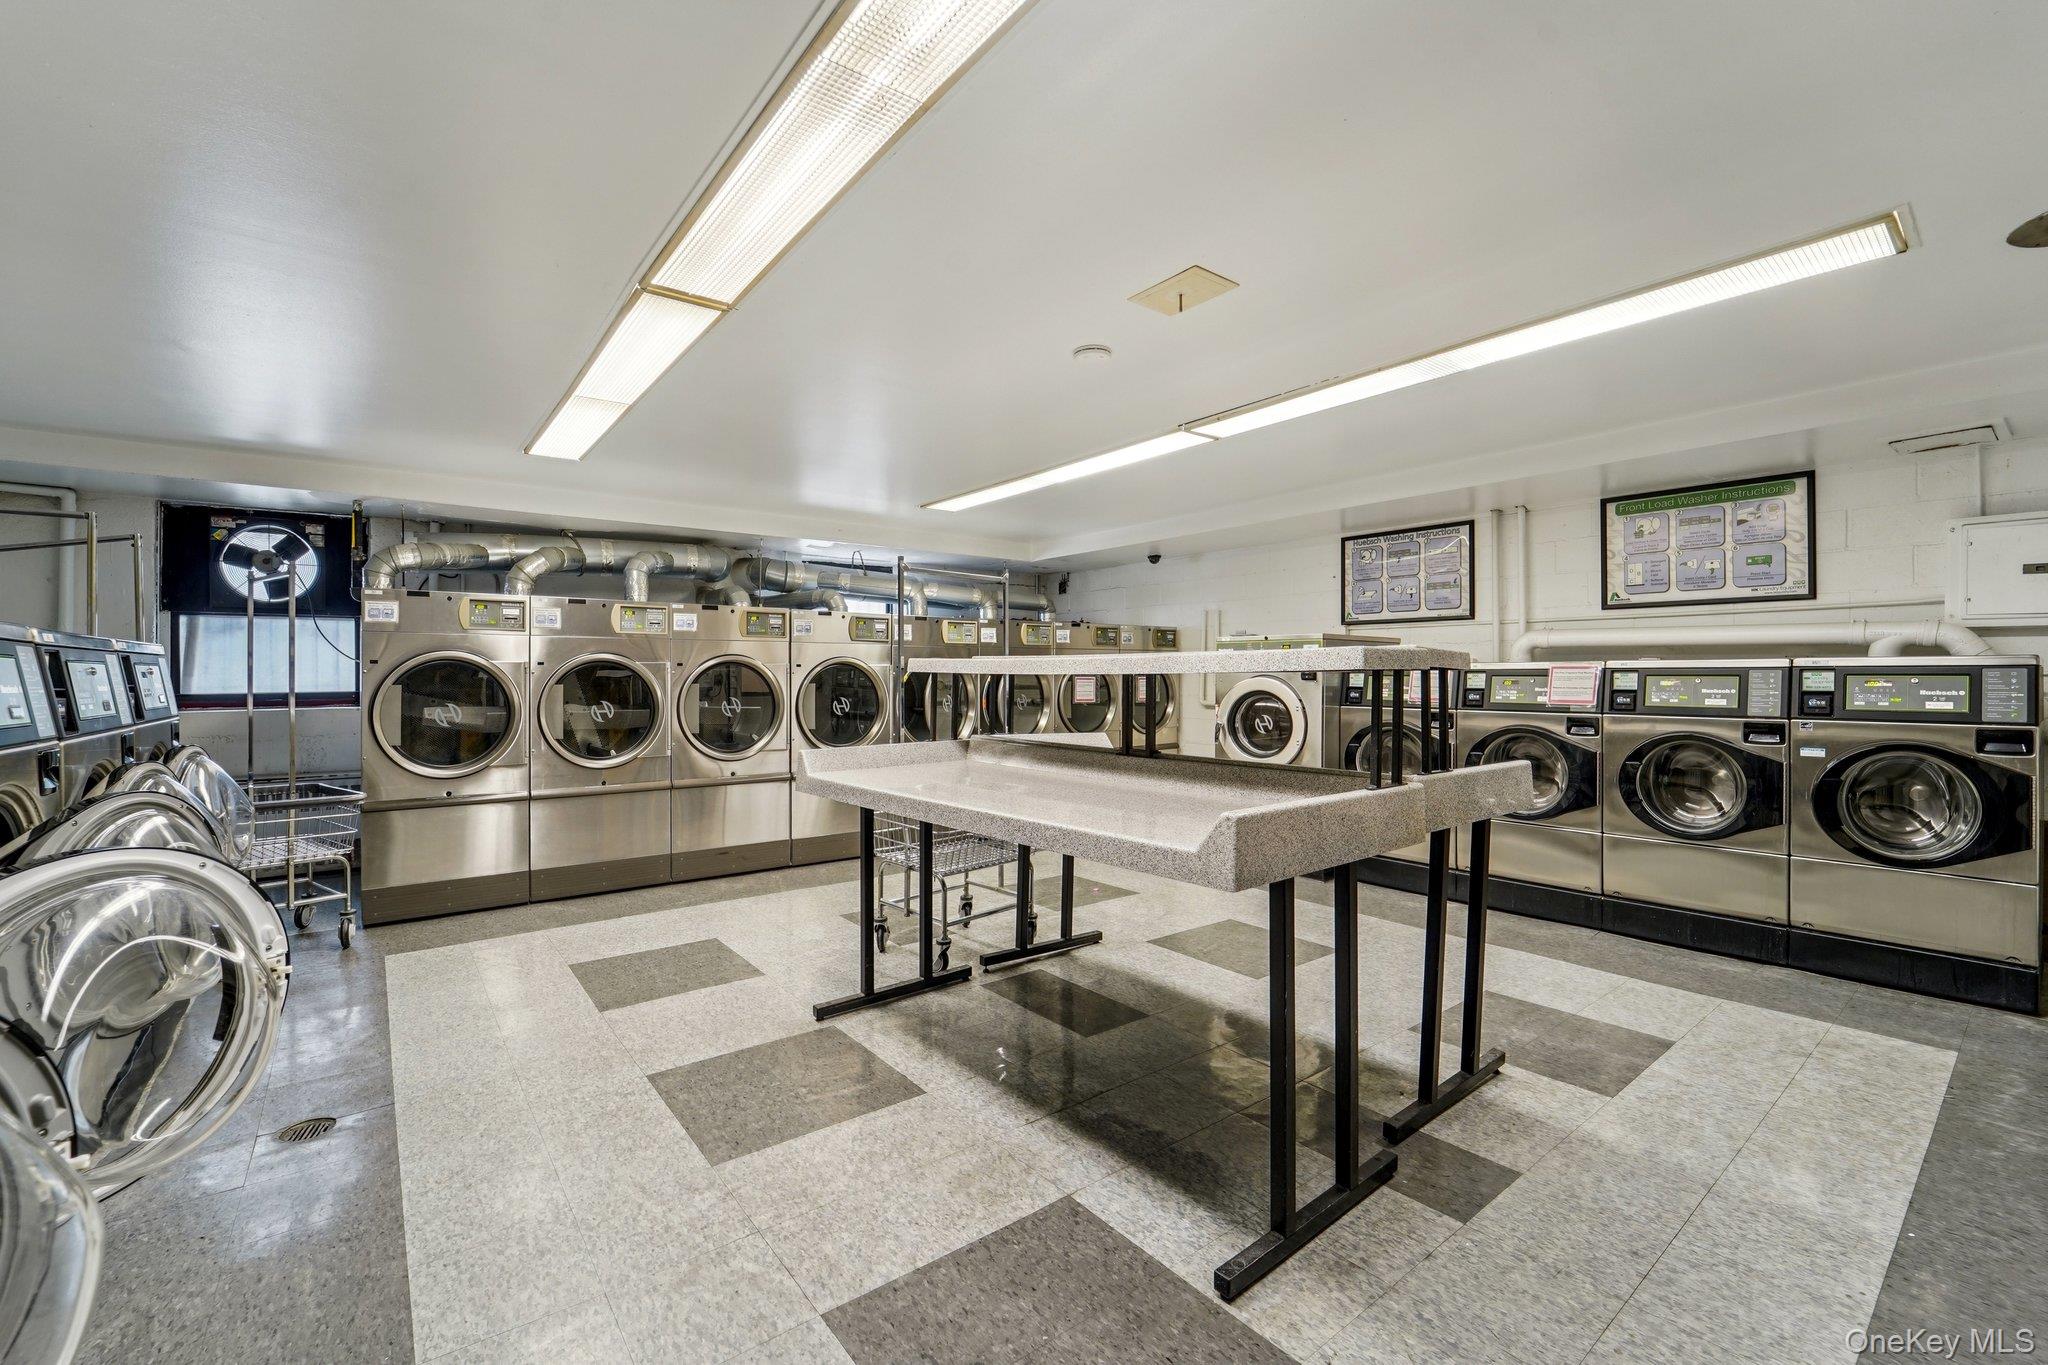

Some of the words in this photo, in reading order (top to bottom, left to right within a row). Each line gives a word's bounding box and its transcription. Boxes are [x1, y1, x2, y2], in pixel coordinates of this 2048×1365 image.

[1619, 503, 1645, 513] Front
[1648, 499, 1674, 510] Load
[1677, 493, 1718, 505] Washer
[1722, 484, 1791, 500] Instructions
[1352, 537, 1382, 547] Huebsch
[1383, 531, 1415, 543] Washing
[1416, 527, 1461, 539] Instructions
